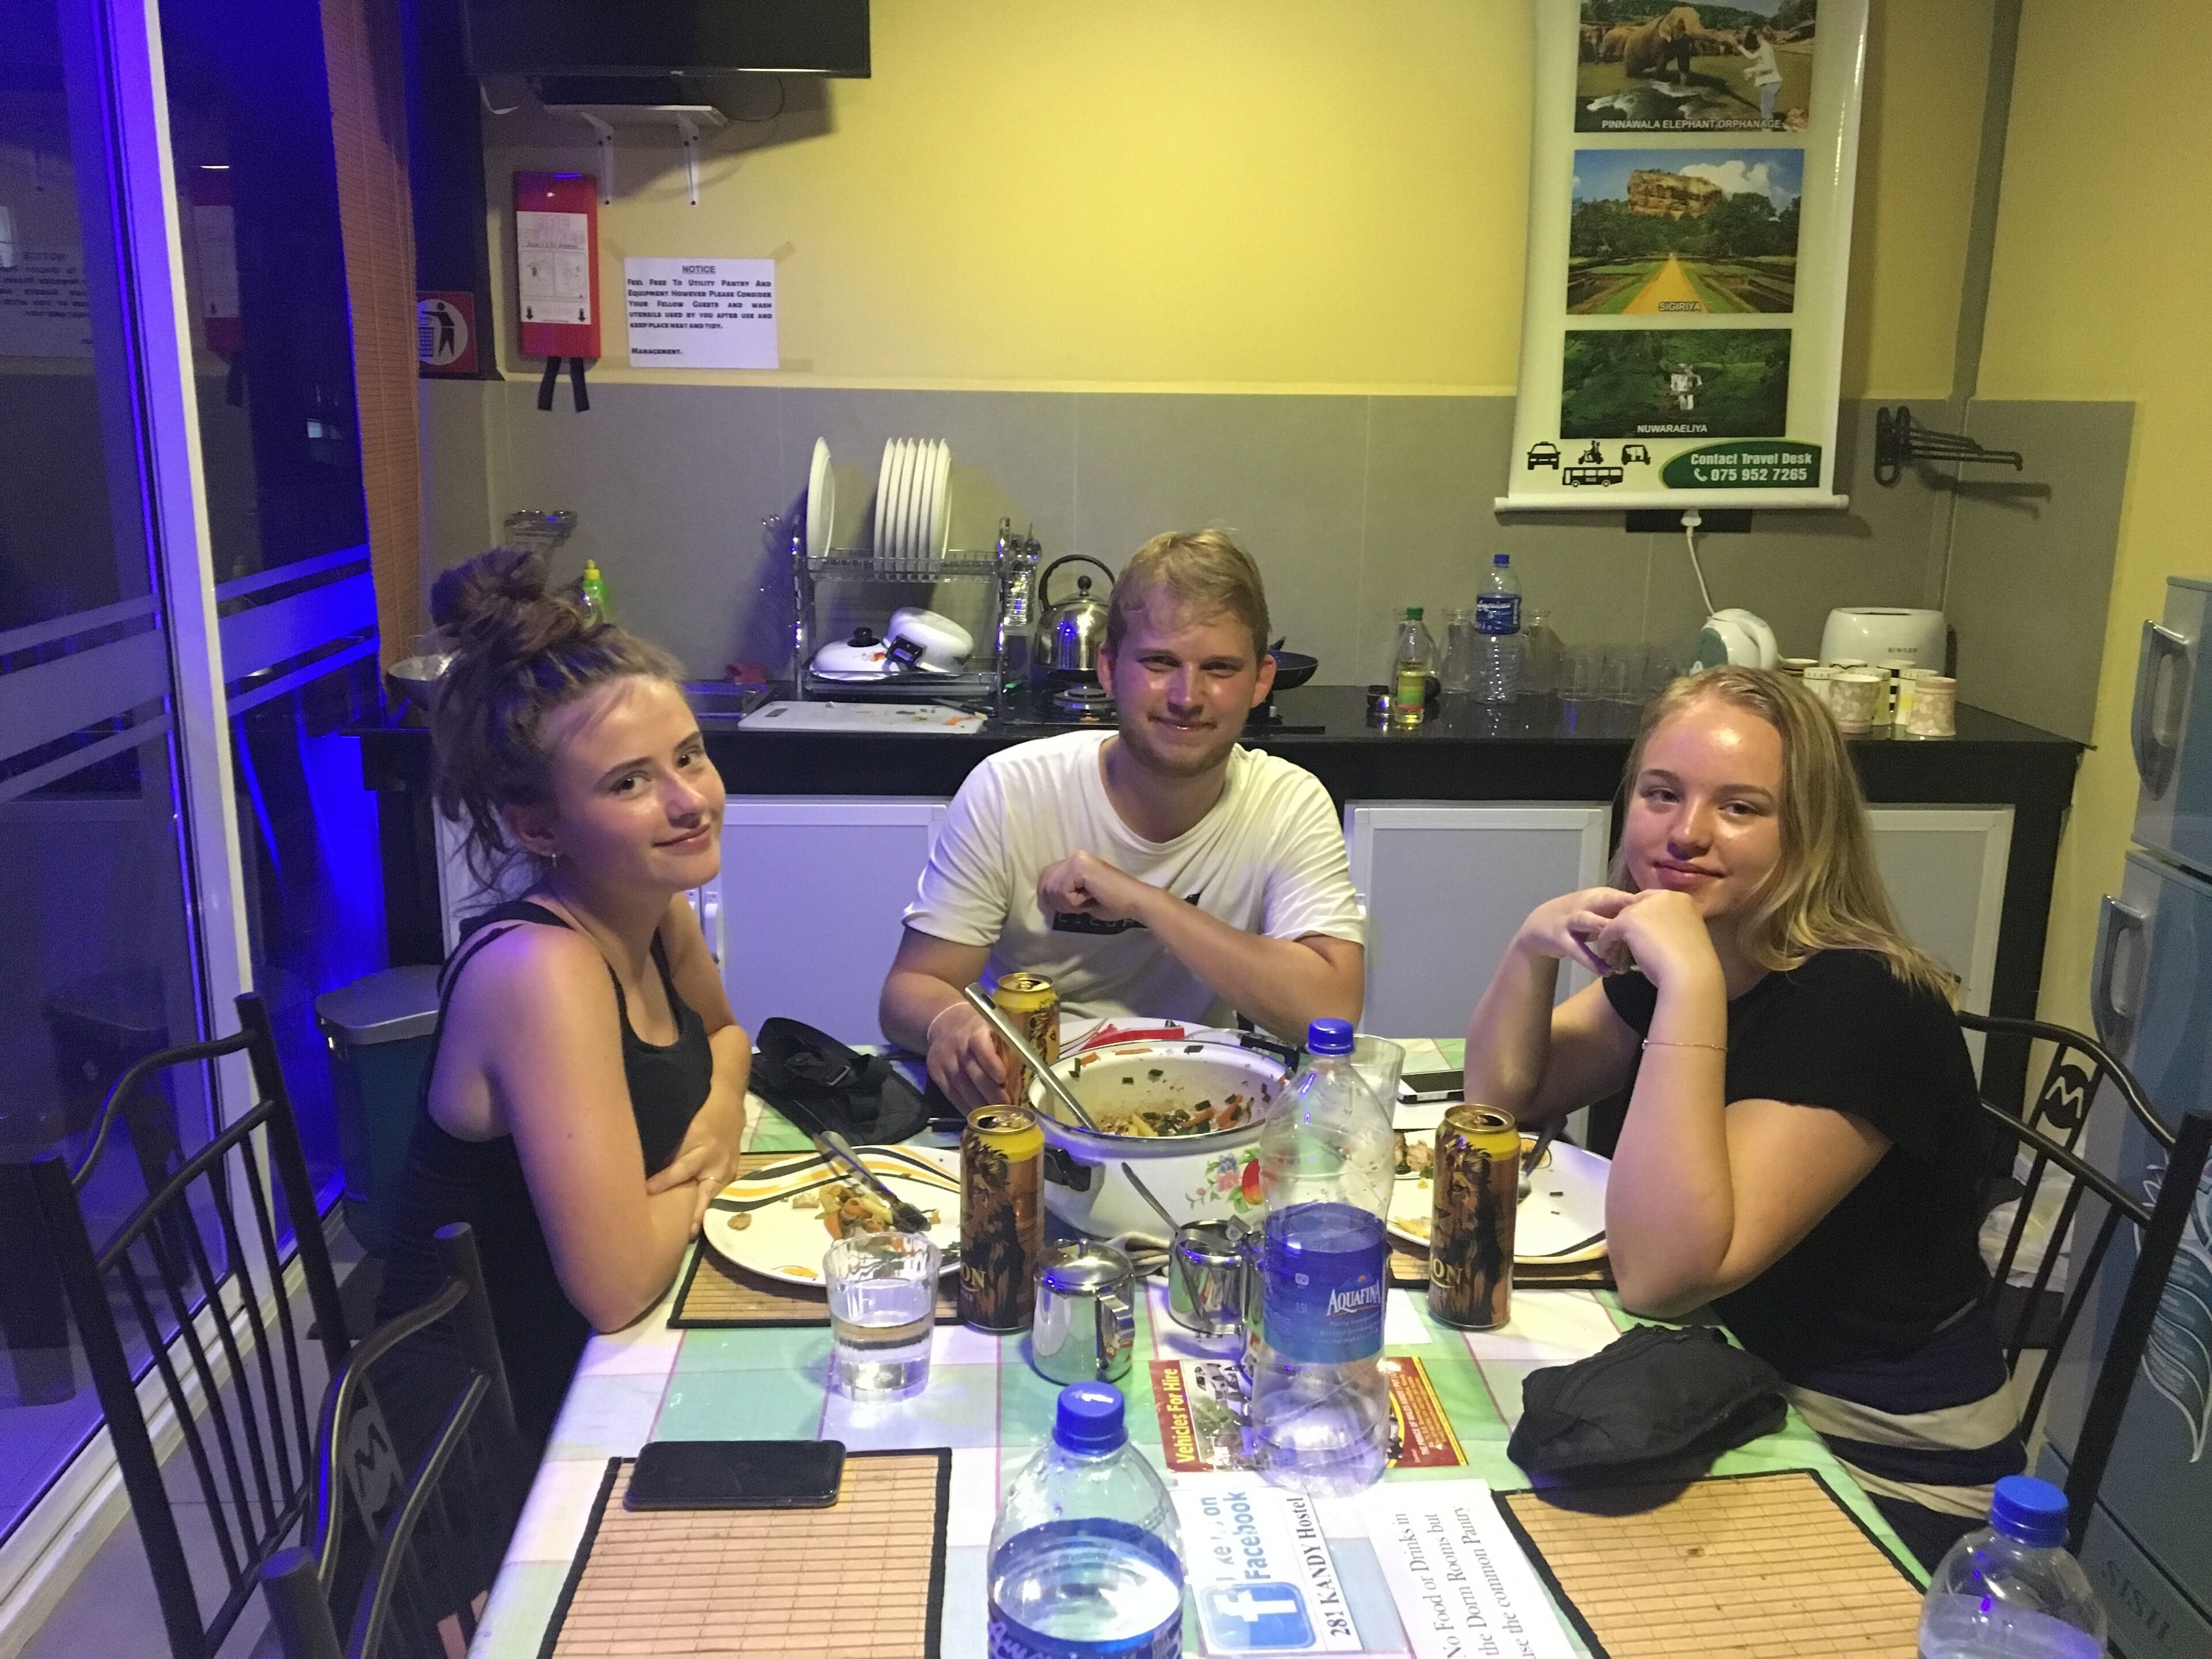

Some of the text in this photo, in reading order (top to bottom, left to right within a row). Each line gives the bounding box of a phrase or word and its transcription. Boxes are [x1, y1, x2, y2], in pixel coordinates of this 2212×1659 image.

[1601, 119, 1782, 128] PINNAWALA ELEPHANT ORPHANAGE
[682, 266, 715, 274] NOTICE
[1659, 302, 1701, 311] SIGIRIYA
[1637, 425, 1707, 433] NUWARAELIYA
[1691, 453, 1812, 465] Contact Travel Desk
[1711, 468, 1808, 481] 075 952 7265
[1161, 1368, 1195, 1463] Vehicles For Hire
[1200, 1497, 1221, 1516] on
[1392, 1514, 1410, 1525] in
[1453, 1506, 1481, 1544] Pantry
[1222, 1491, 1271, 1580] Facebook
[1399, 1528, 1429, 1571] Drinks
[1286, 1498, 1351, 1636] 281 KANDY Hostel
[1421, 1575, 1437, 1590] or
[1425, 1514, 1499, 1656] the Dorm Rooms but
[1474, 1548, 1511, 1608] common
[1423, 1594, 1454, 1631] Food
[1502, 1612, 1524, 1633] the
